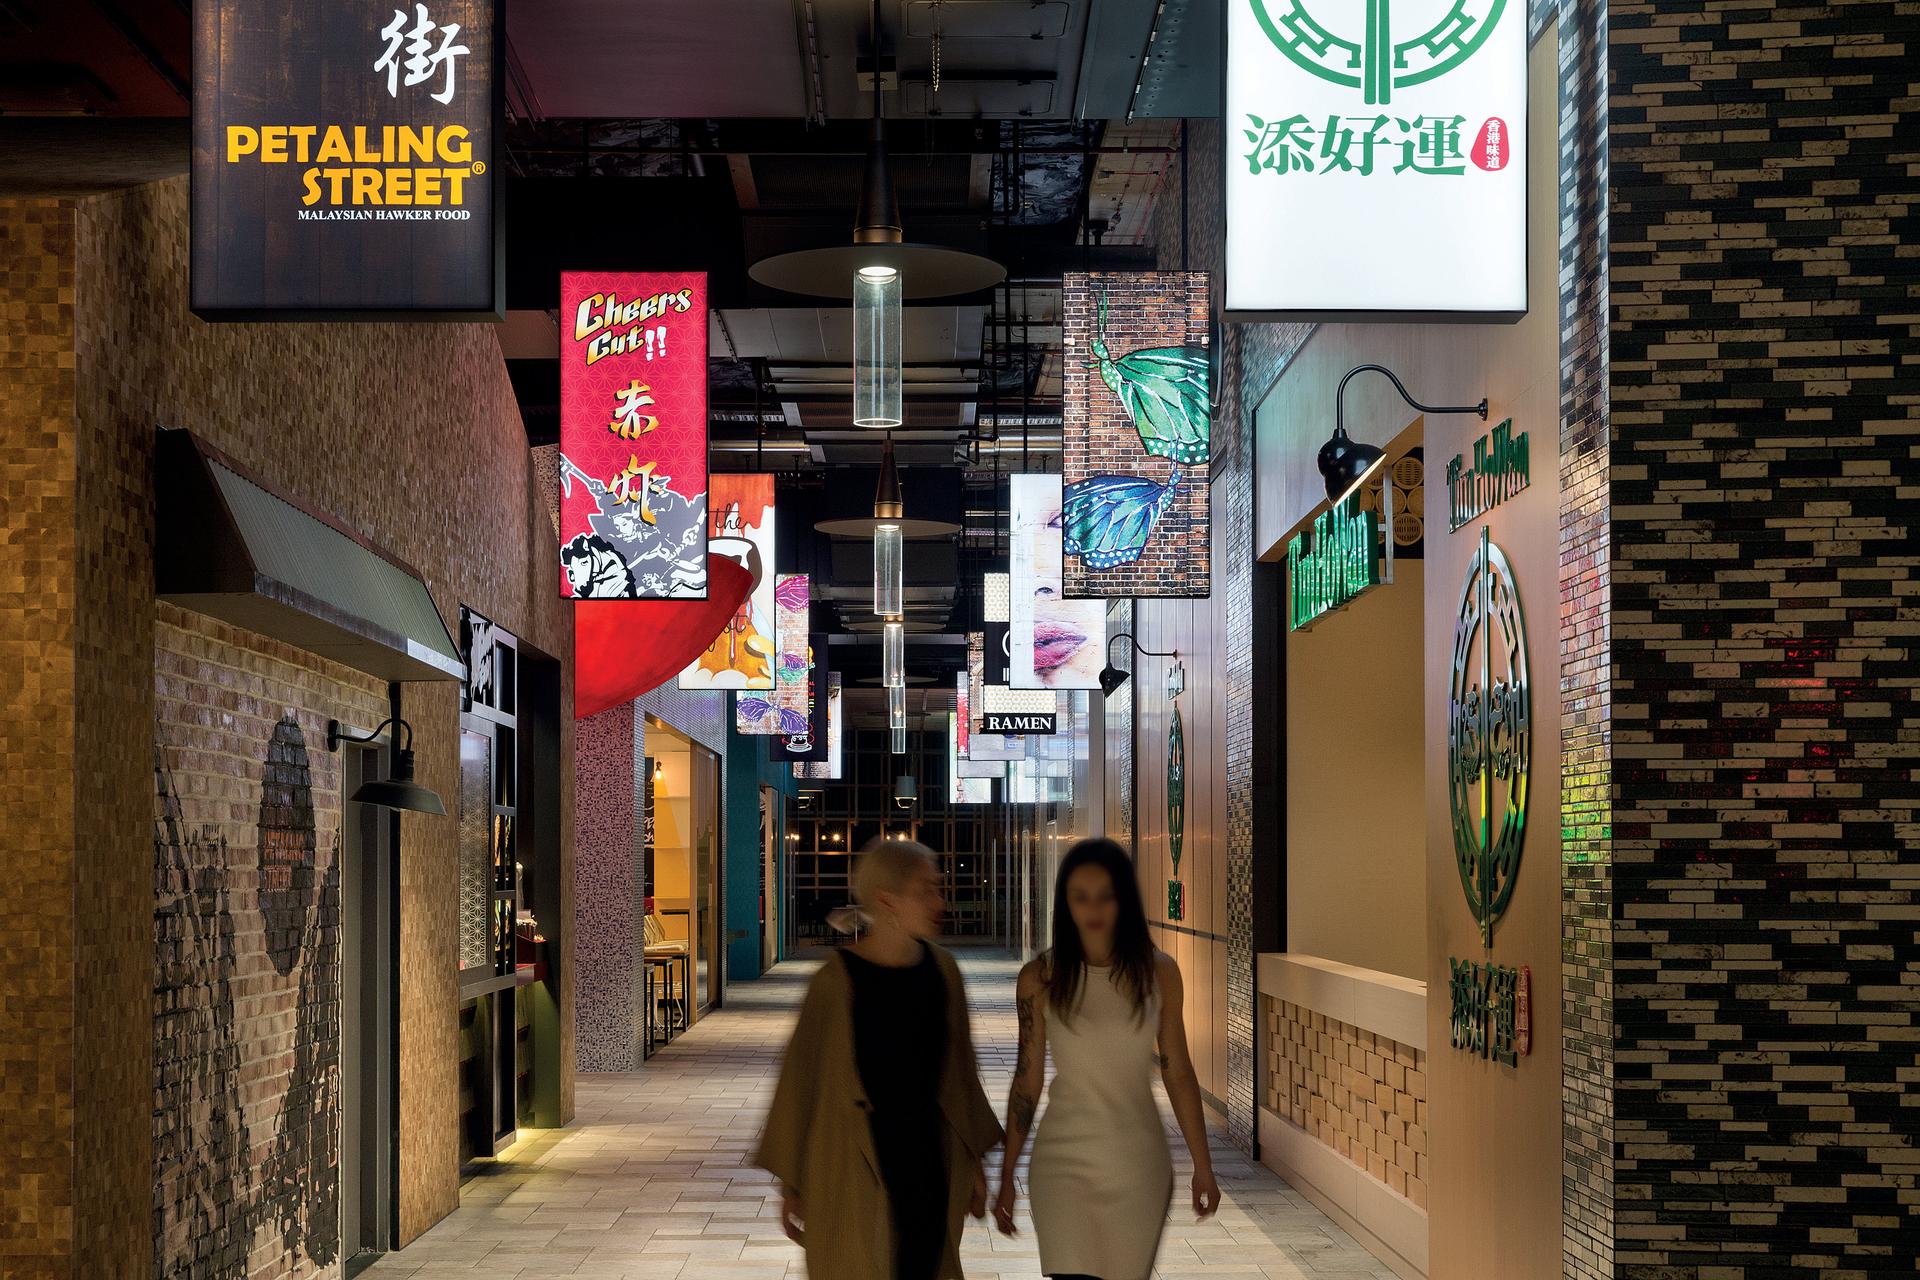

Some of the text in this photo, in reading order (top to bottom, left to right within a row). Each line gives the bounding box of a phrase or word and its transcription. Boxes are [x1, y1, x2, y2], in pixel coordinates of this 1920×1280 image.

[374, 2, 470, 105] 街
[226, 125, 473, 163] PETALING
[1243, 113, 1467, 176] 添好運
[297, 209, 471, 221] MALAYSIAN HAWKER FOOD
[574, 288, 693, 341] Cheers
[987, 716, 1053, 731] RAMEN
